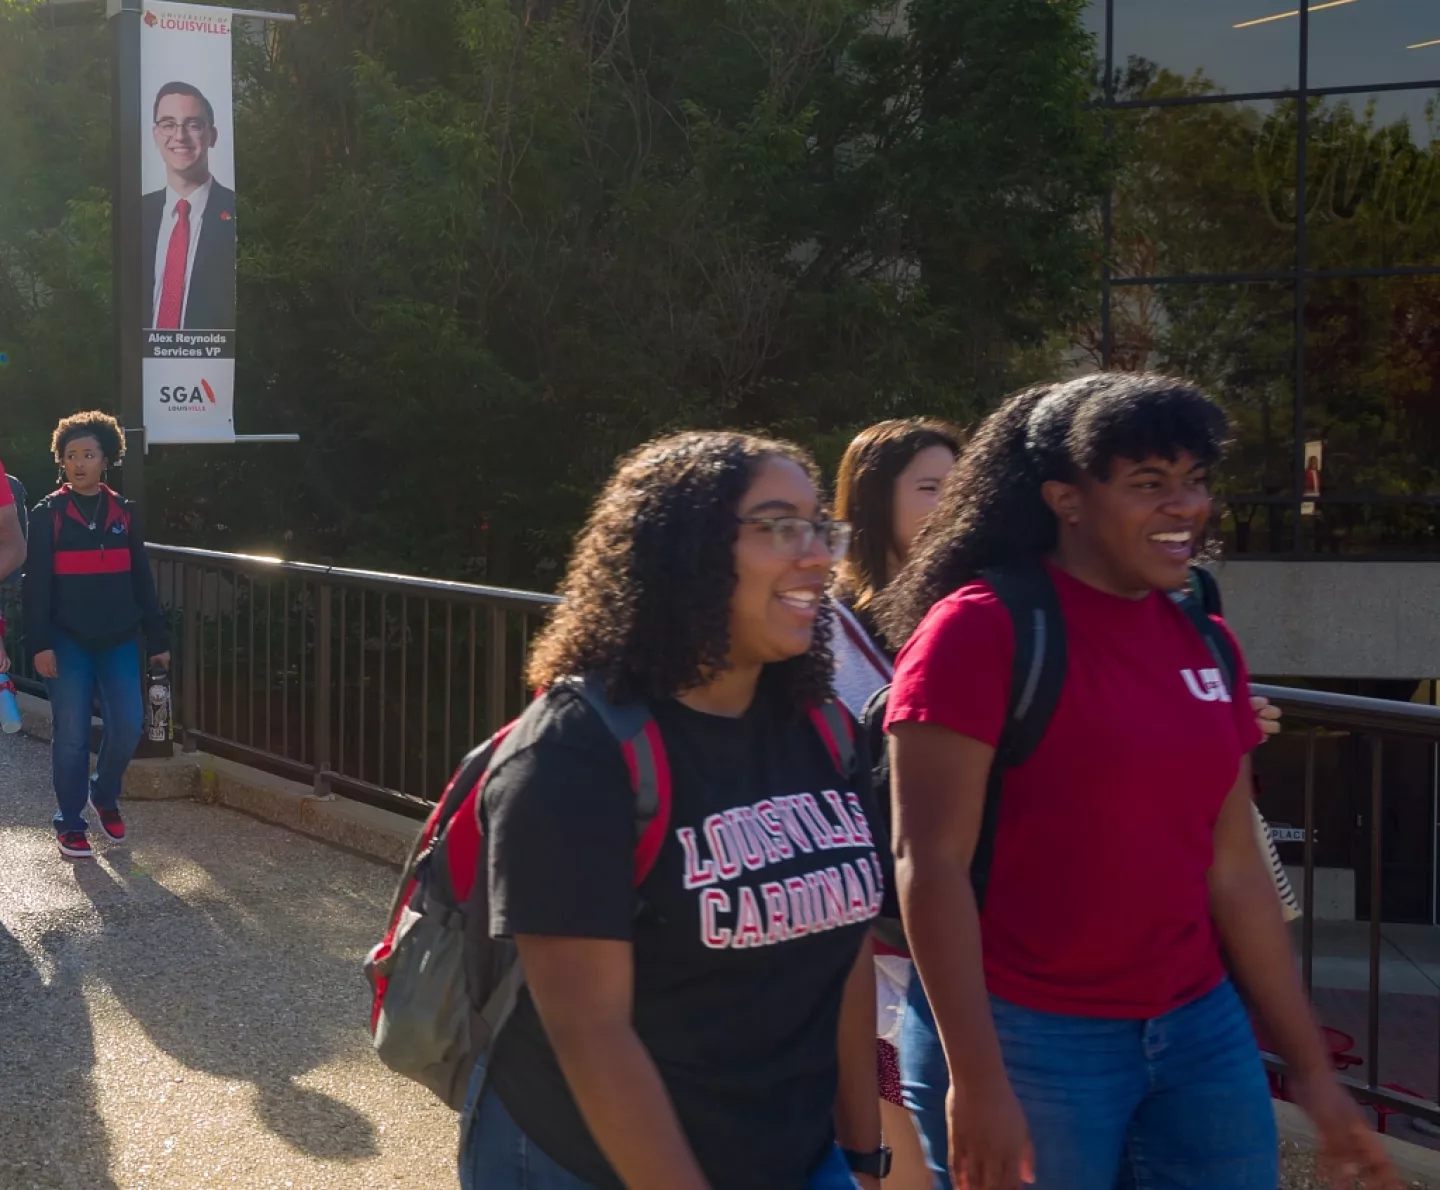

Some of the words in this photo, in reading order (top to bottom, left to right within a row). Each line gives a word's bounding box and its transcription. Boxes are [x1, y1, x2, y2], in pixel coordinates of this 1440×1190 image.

[161, 18, 227, 34] LOUISVILLE
[148, 333, 173, 343] Alex
[176, 333, 226, 345] Reynolds
[154, 346, 202, 357] Services
[205, 347, 221, 357] VP
[160, 386, 203, 403] SGA
